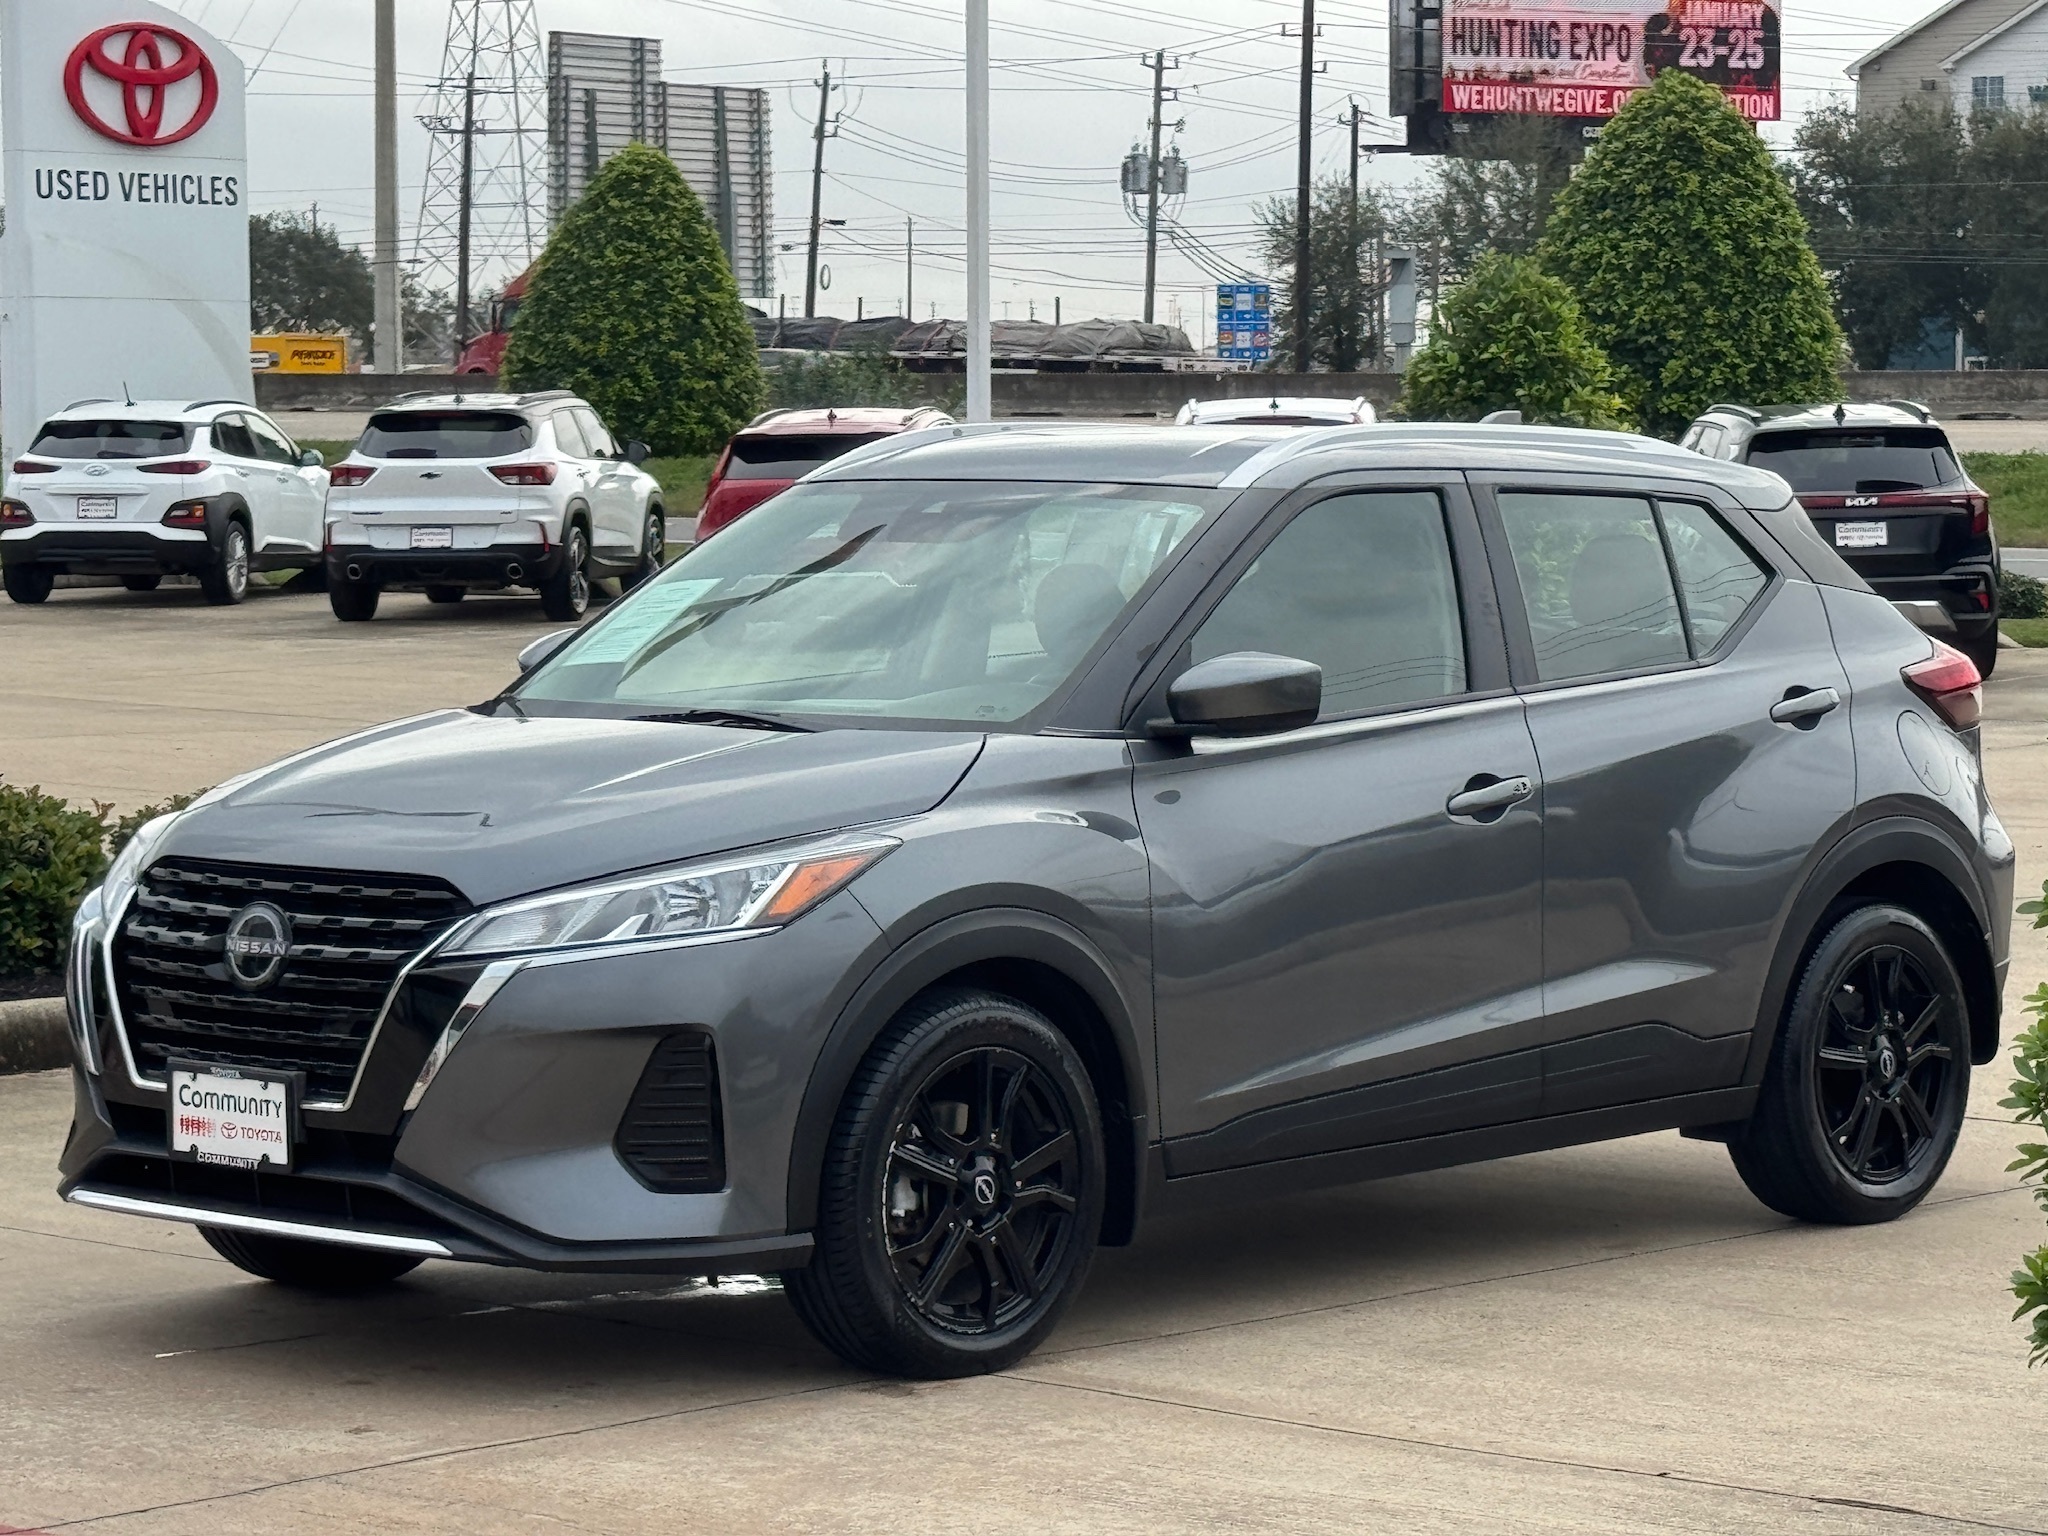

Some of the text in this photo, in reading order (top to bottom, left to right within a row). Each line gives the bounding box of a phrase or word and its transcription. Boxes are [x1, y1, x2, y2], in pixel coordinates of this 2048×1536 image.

[1679, 2, 1765, 28] JANUARY
[1452, 17, 1632, 63] HUNTING EXPO
[1678, 27, 1765, 70] 23-25
[1451, 84, 1775, 119] WEHUNTWEGIVE.O TION
[35, 168, 238, 207] USED VEHICLES
[226, 938, 287, 956] NISSAN
[240, 1126, 283, 1144] TOYOTA
[197, 1151, 260, 1170] COMMUNITY
